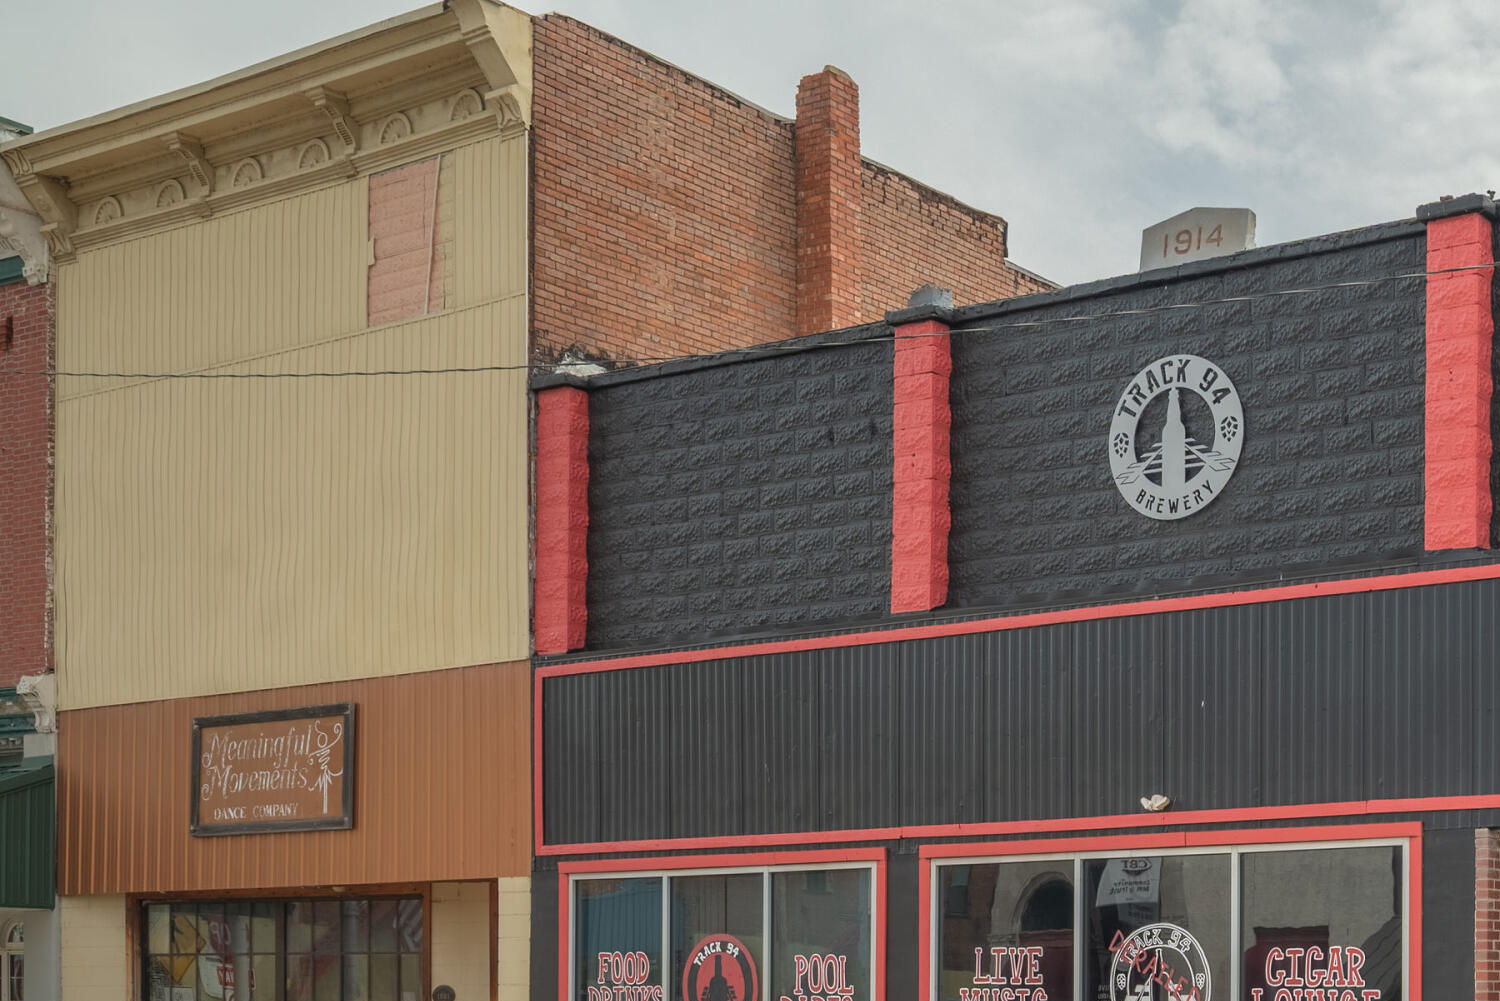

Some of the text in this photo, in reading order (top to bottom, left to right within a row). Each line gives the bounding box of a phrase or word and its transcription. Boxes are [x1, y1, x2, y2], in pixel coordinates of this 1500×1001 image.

[1162, 223, 1224, 258] 1914
[1117, 358, 1232, 420] TRACK 94
[1135, 479, 1214, 515] BREWERY
[202, 724, 312, 768] Meaningful
[201, 762, 308, 800] Movements
[213, 803, 299, 820] DANCE COMPANY
[693, 941, 740, 966] TRACK 94
[1167, 930, 1192, 953] 94
[597, 951, 651, 985] FOOD
[793, 954, 855, 996] POOL
[973, 946, 1044, 985] LIVE
[1264, 945, 1367, 989] CIGAR
